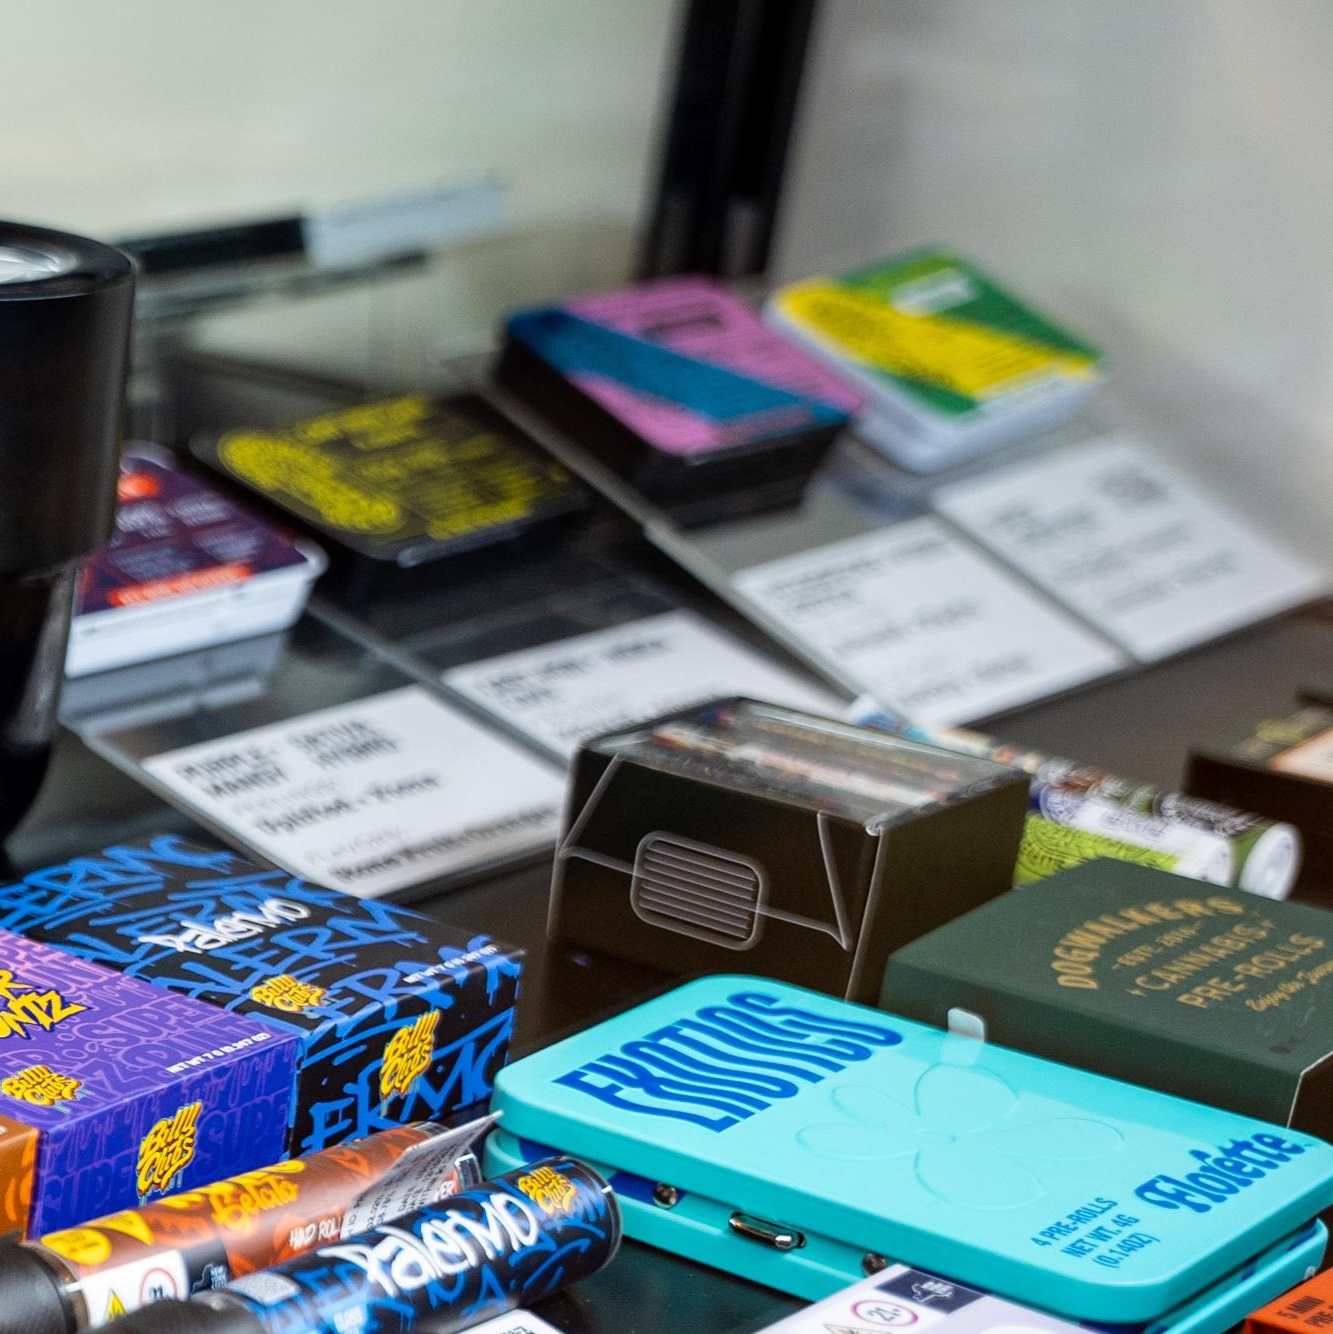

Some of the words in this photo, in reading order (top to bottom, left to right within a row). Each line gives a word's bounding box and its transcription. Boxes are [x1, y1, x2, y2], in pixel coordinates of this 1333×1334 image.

[1134, 922, 1269, 991] CANNABIS
[1176, 931, 1326, 1010] PRE-ROLLS
[386, 1009, 441, 1063] Billy
[551, 990, 904, 1134] EXOTICS
[1, 1064, 51, 1098] Billy
[381, 1044, 435, 1098] Clubs
[141, 1101, 203, 1156] Billy
[137, 1134, 197, 1196] Clubs
[518, 1166, 561, 1198] Billy
[1031, 1235, 1046, 1249] 4
[1039, 1196, 1118, 1242] PRE-ROLLS
[1061, 1239, 1092, 1259] NET
[1088, 1225, 1118, 1246] WT.
[1110, 1212, 1141, 1232] 4G
[1290, 1294, 1327, 1315] MINI
